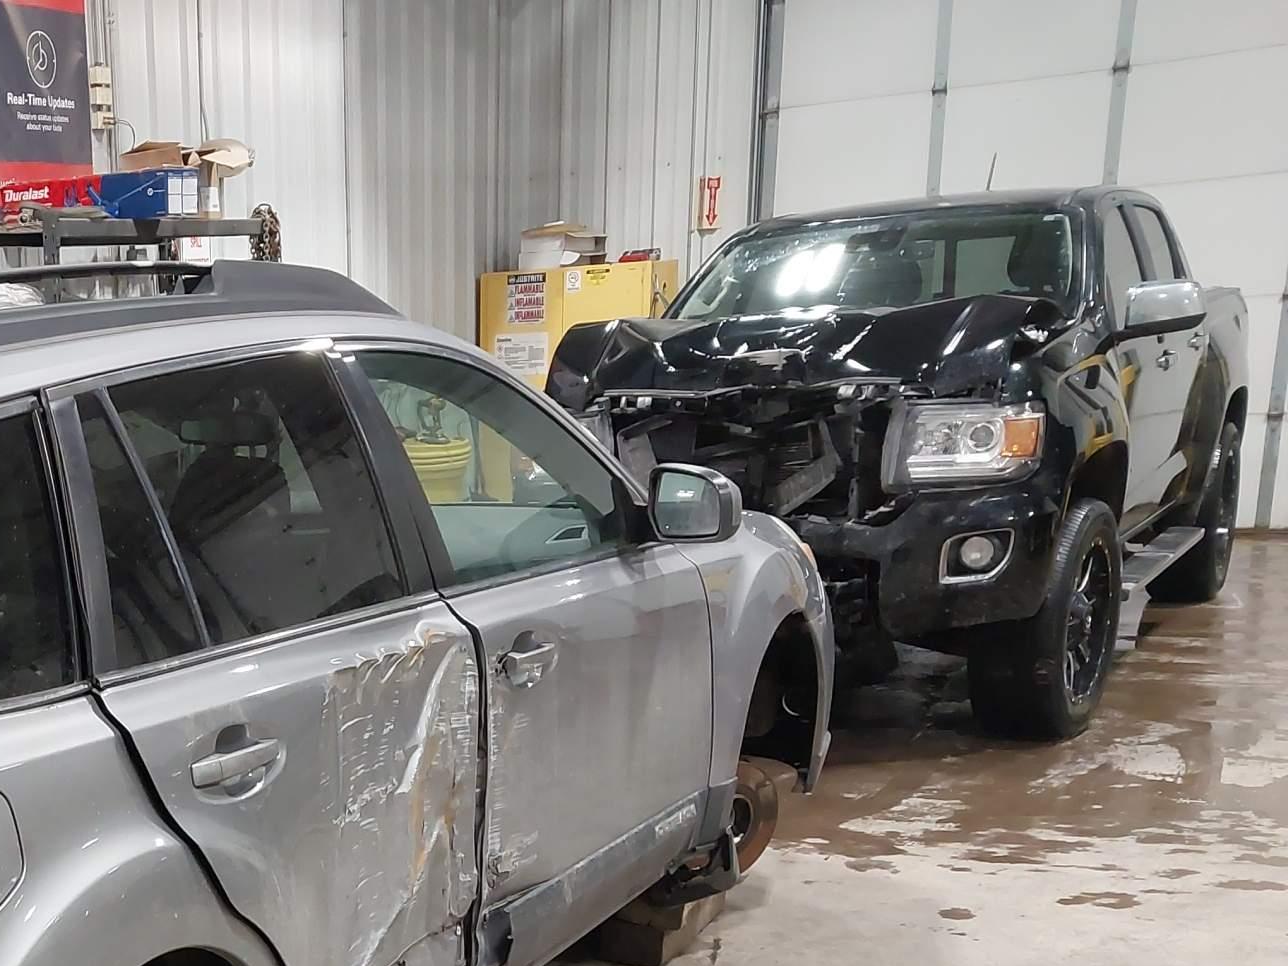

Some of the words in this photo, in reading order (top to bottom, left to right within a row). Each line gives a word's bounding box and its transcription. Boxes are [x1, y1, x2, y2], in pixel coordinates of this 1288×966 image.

[6, 92, 47, 107] Real-Time
[47, 95, 75, 111] Updates
[3, 186, 50, 203] Duralast
[515, 283, 545, 294] FLAMMABLE
